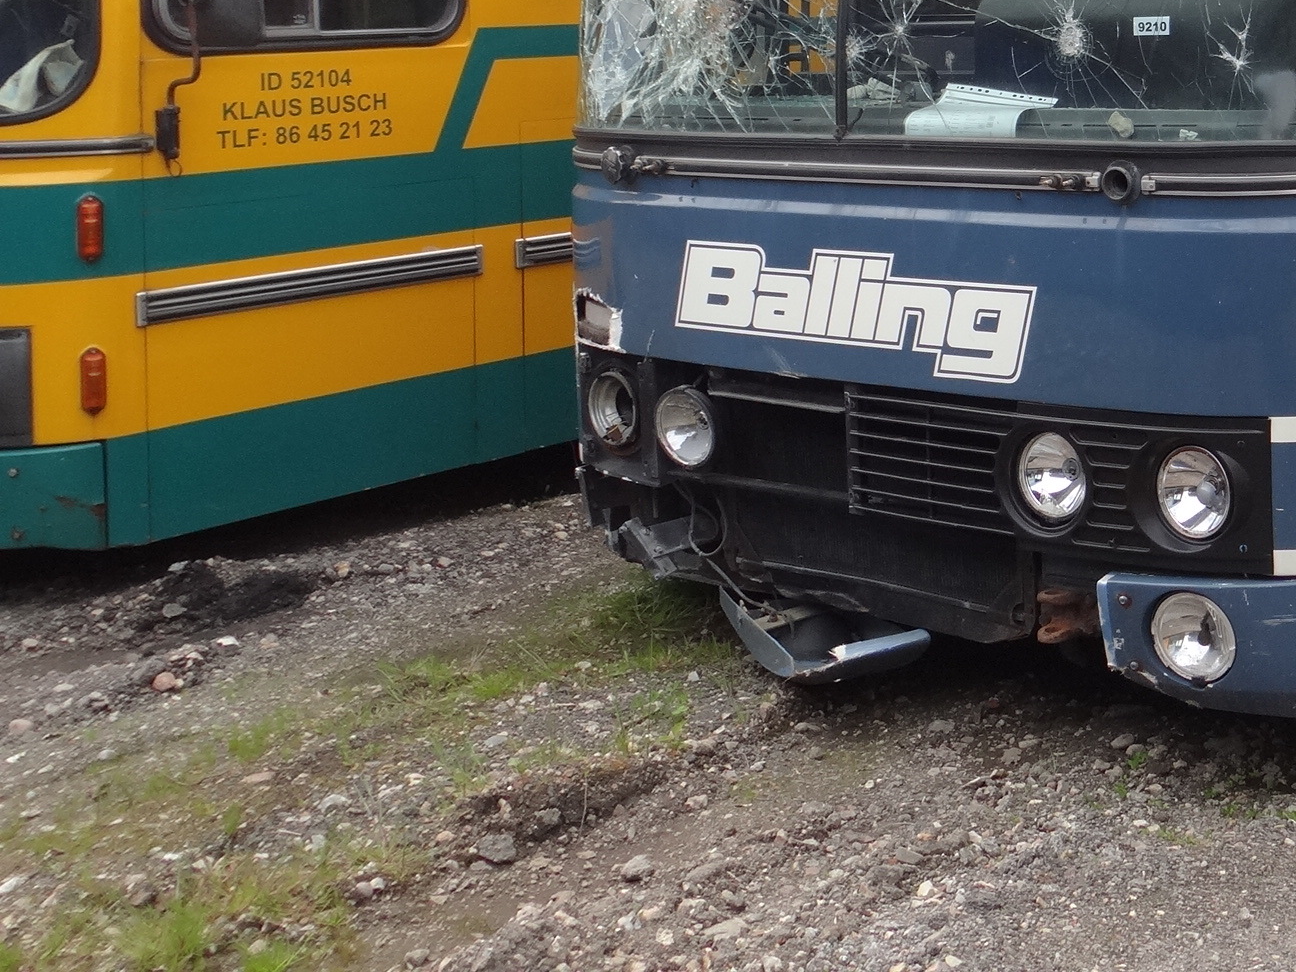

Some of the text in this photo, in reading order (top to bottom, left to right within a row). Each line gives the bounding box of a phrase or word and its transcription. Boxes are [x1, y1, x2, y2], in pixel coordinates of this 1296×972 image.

[1138, 22, 1167, 32] 9210
[261, 69, 352, 90] ID 52104
[222, 93, 387, 121] KLAUS BUSCH
[217, 119, 392, 149] TLF: 86 45 21 23
[675, 240, 1037, 384] Balling
